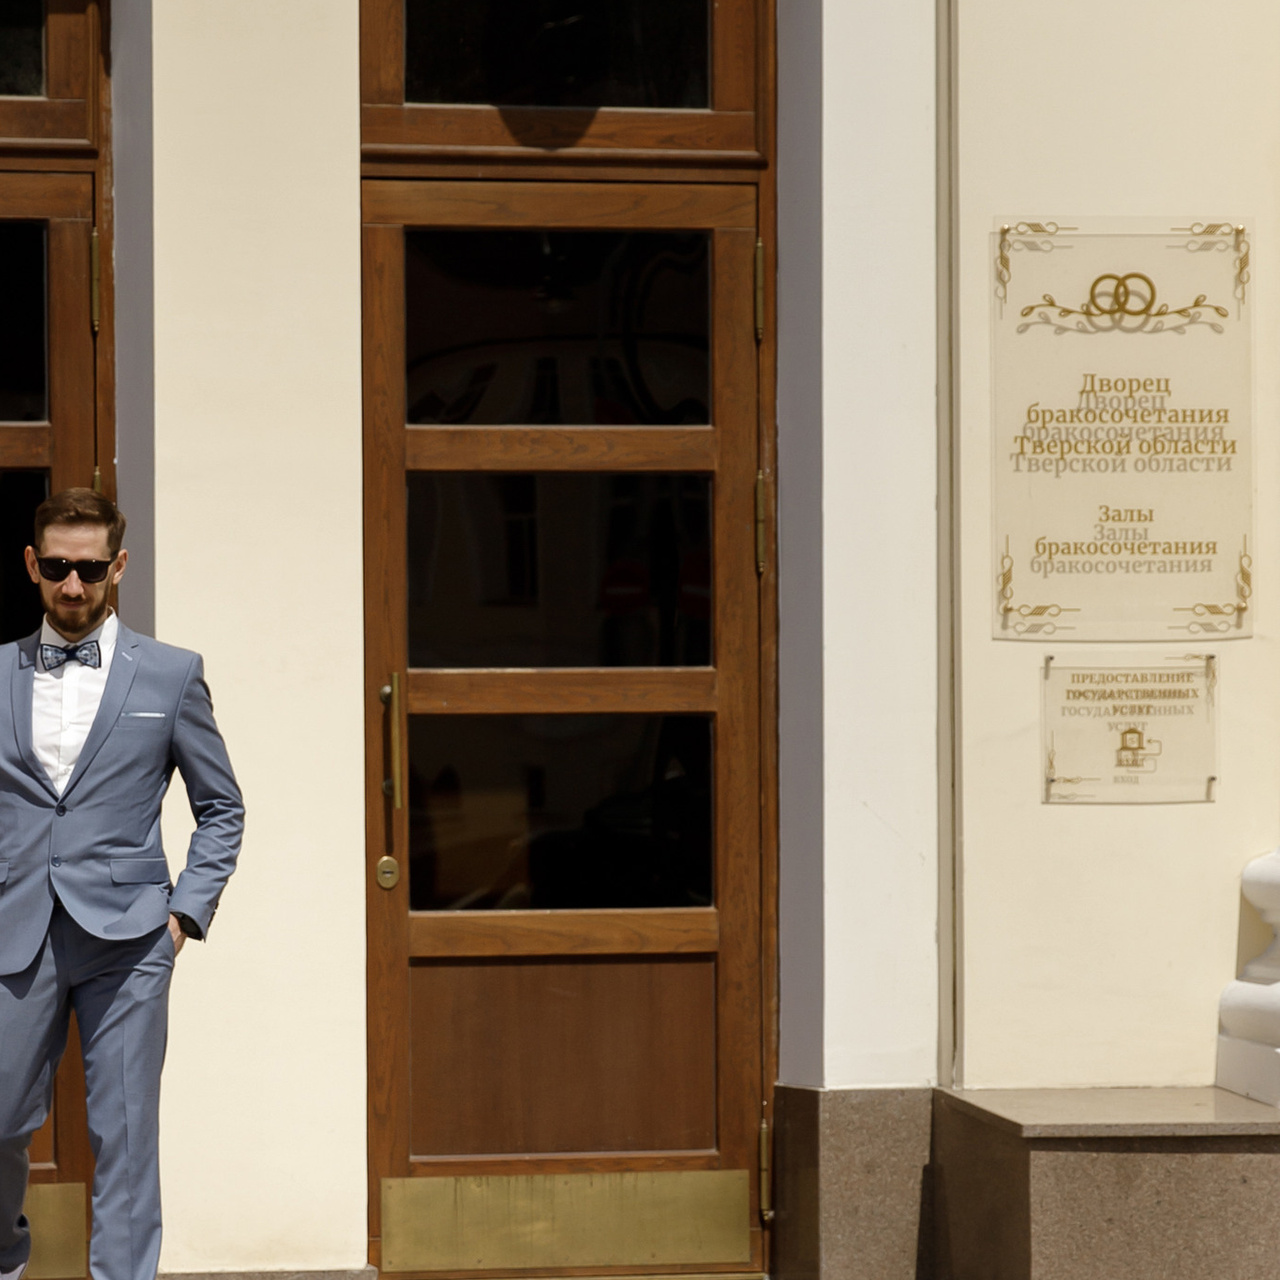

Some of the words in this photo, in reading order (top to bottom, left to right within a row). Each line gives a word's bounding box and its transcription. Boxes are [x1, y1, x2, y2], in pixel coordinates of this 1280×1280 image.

[1080, 373, 1172, 397] Дворец
[1026, 402, 1229, 429] бракосочетания
[1014, 433, 1131, 461] Тверской
[1138, 433, 1237, 455] области
[1098, 505, 1154, 523] Залы
[1034, 536, 1218, 561] бракосочетания
[1071, 673, 1194, 685] ПРЕДОСТАВЛЕНИЕ
[1066, 688, 1199, 701] ГОСУДАРСТВЕННЫХ
